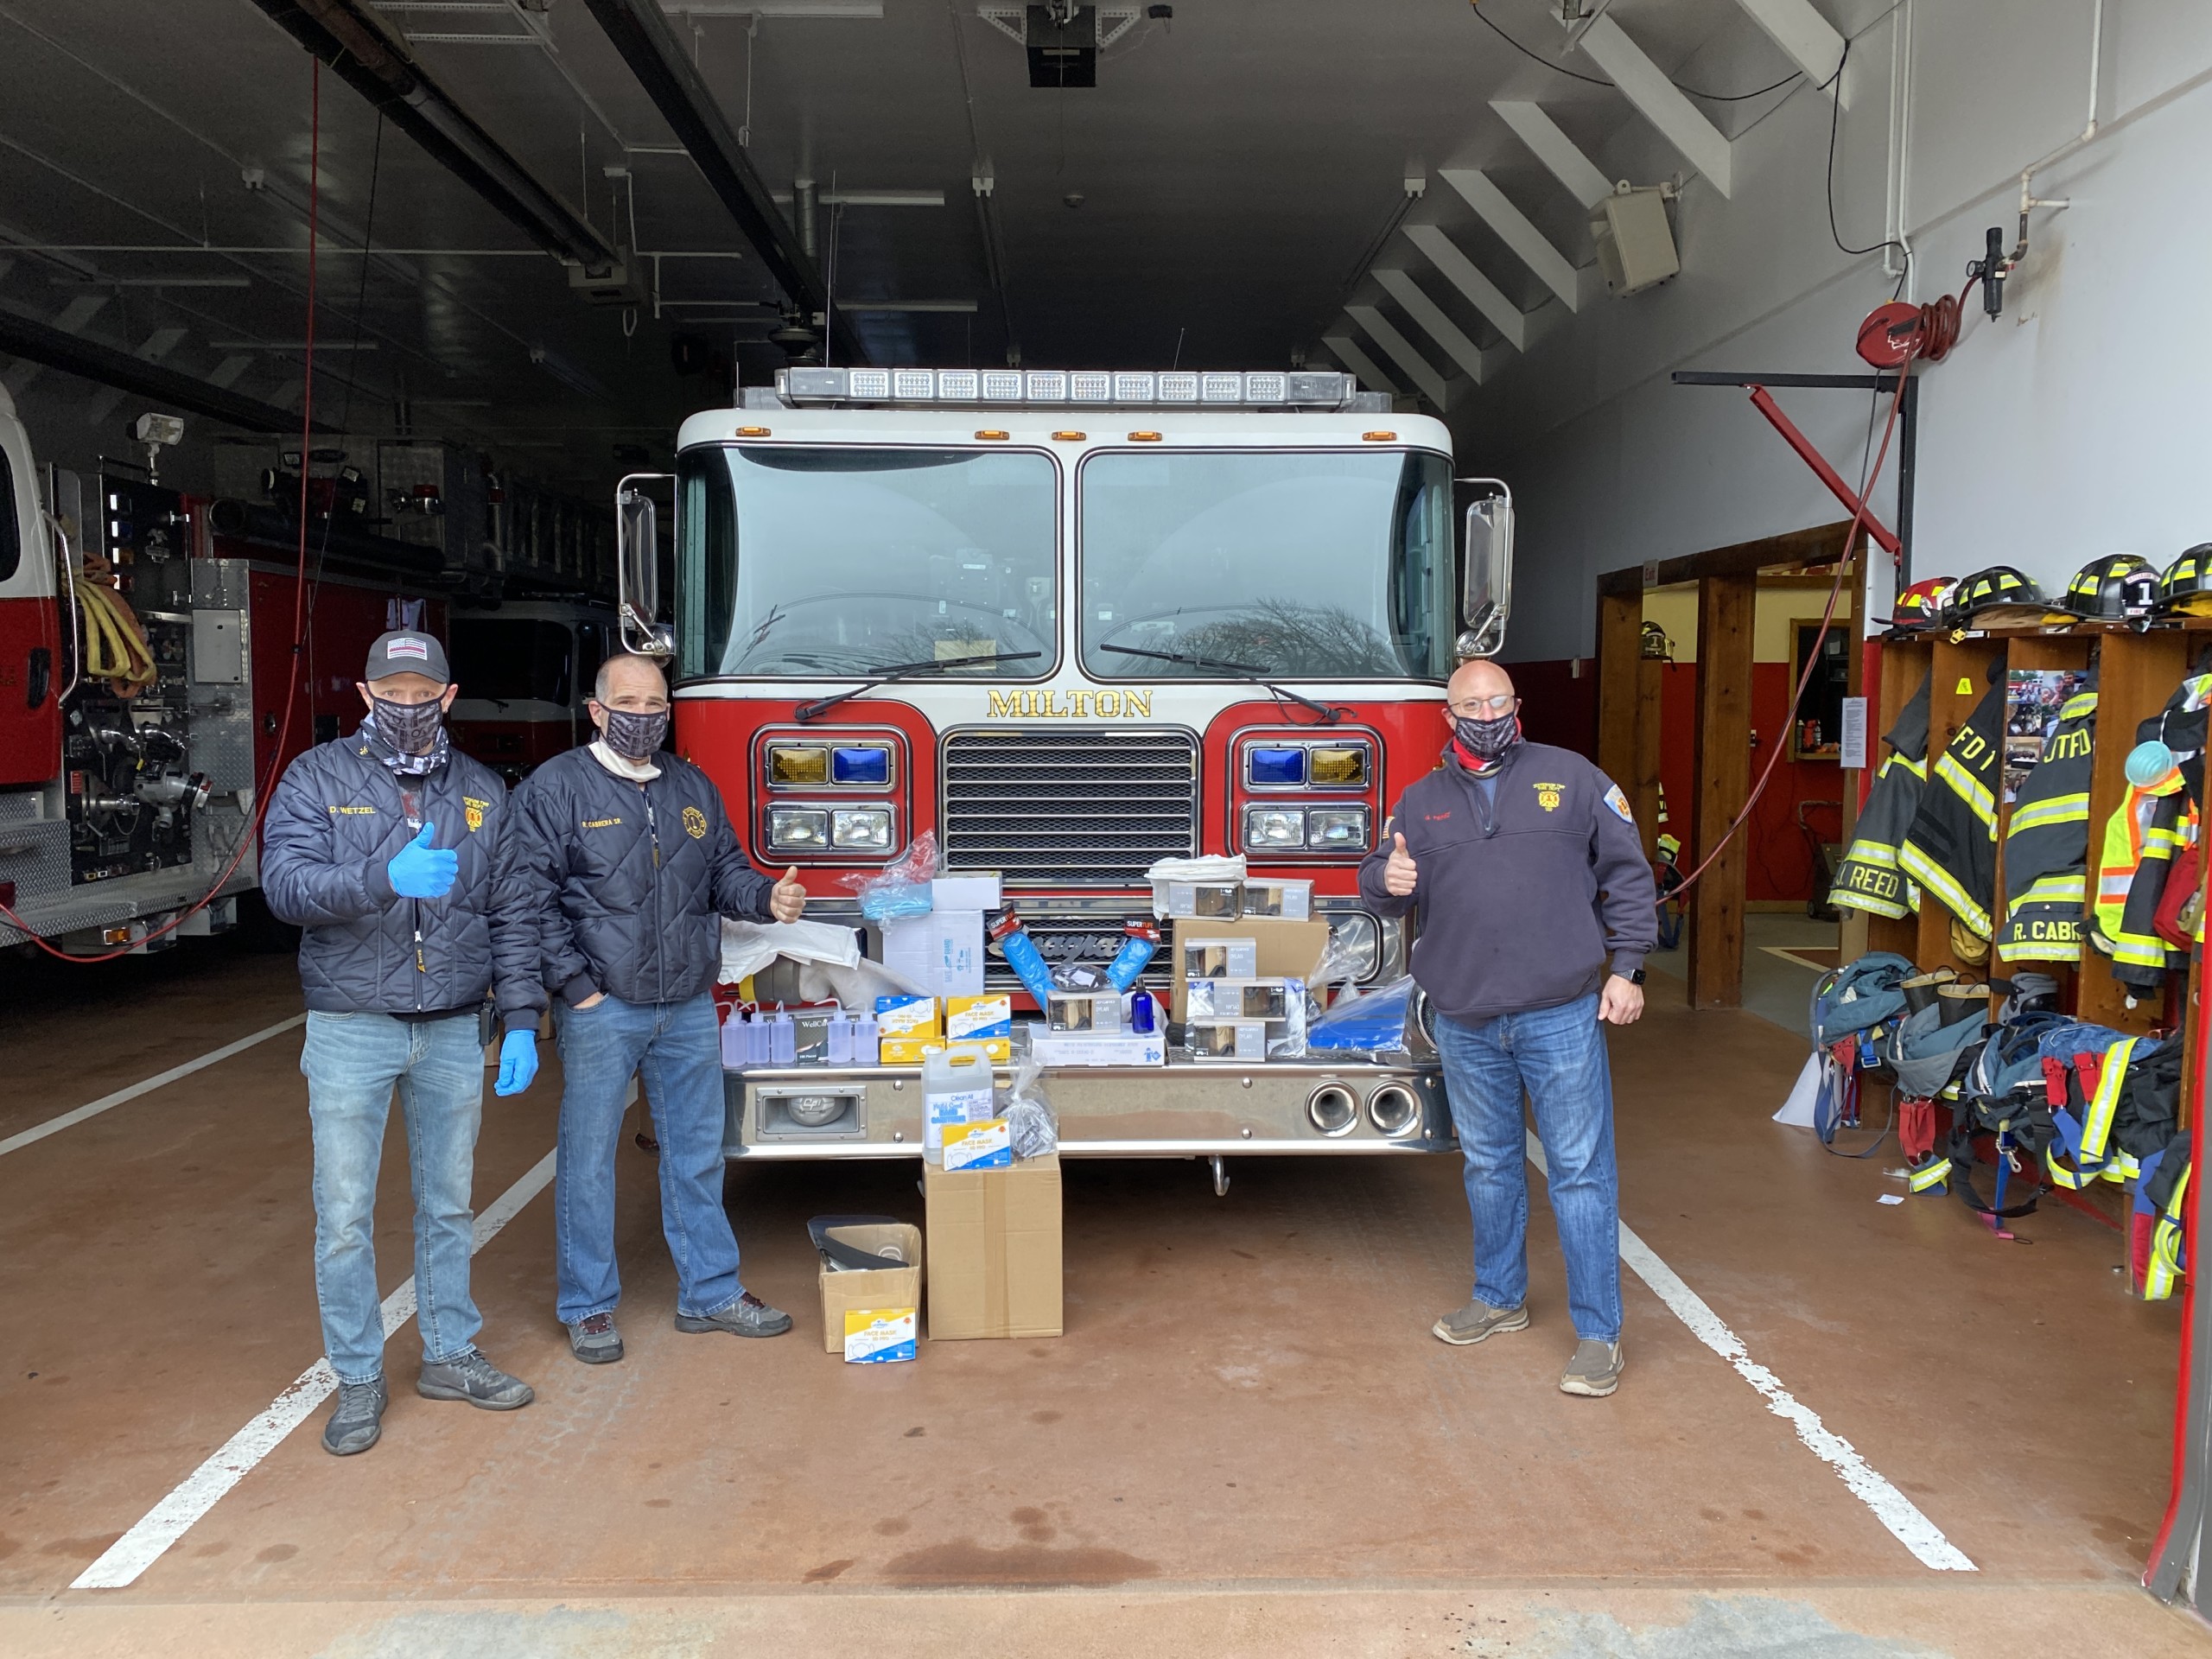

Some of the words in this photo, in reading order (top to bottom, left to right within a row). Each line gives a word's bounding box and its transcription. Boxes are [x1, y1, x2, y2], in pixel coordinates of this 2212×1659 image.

[2139, 582, 2152, 605] 1
[1651, 636, 1658, 646] 1
[987, 690, 1153, 717] MILTON
[2044, 728, 2091, 764] JTFD
[340, 806, 376, 815] WETZEL
[1849, 866, 1899, 899] REED
[2013, 923, 2027, 941] R.
